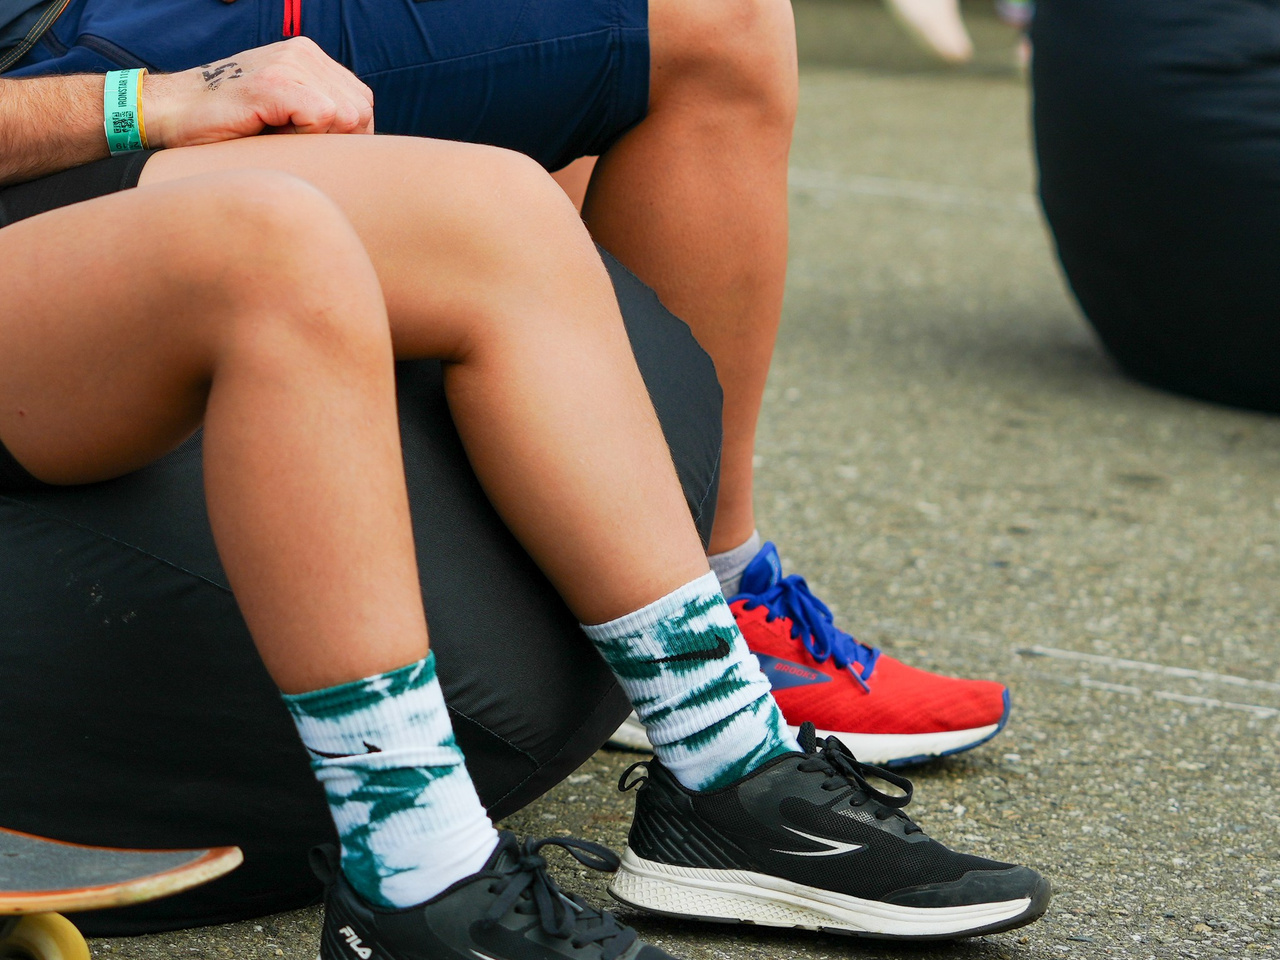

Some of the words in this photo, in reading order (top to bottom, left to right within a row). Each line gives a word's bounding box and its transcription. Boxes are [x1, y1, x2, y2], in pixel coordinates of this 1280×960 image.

[118, 80, 128, 108] IRONSTAR
[774, 662, 818, 681] BROOKS
[338, 925, 373, 960] FILA
